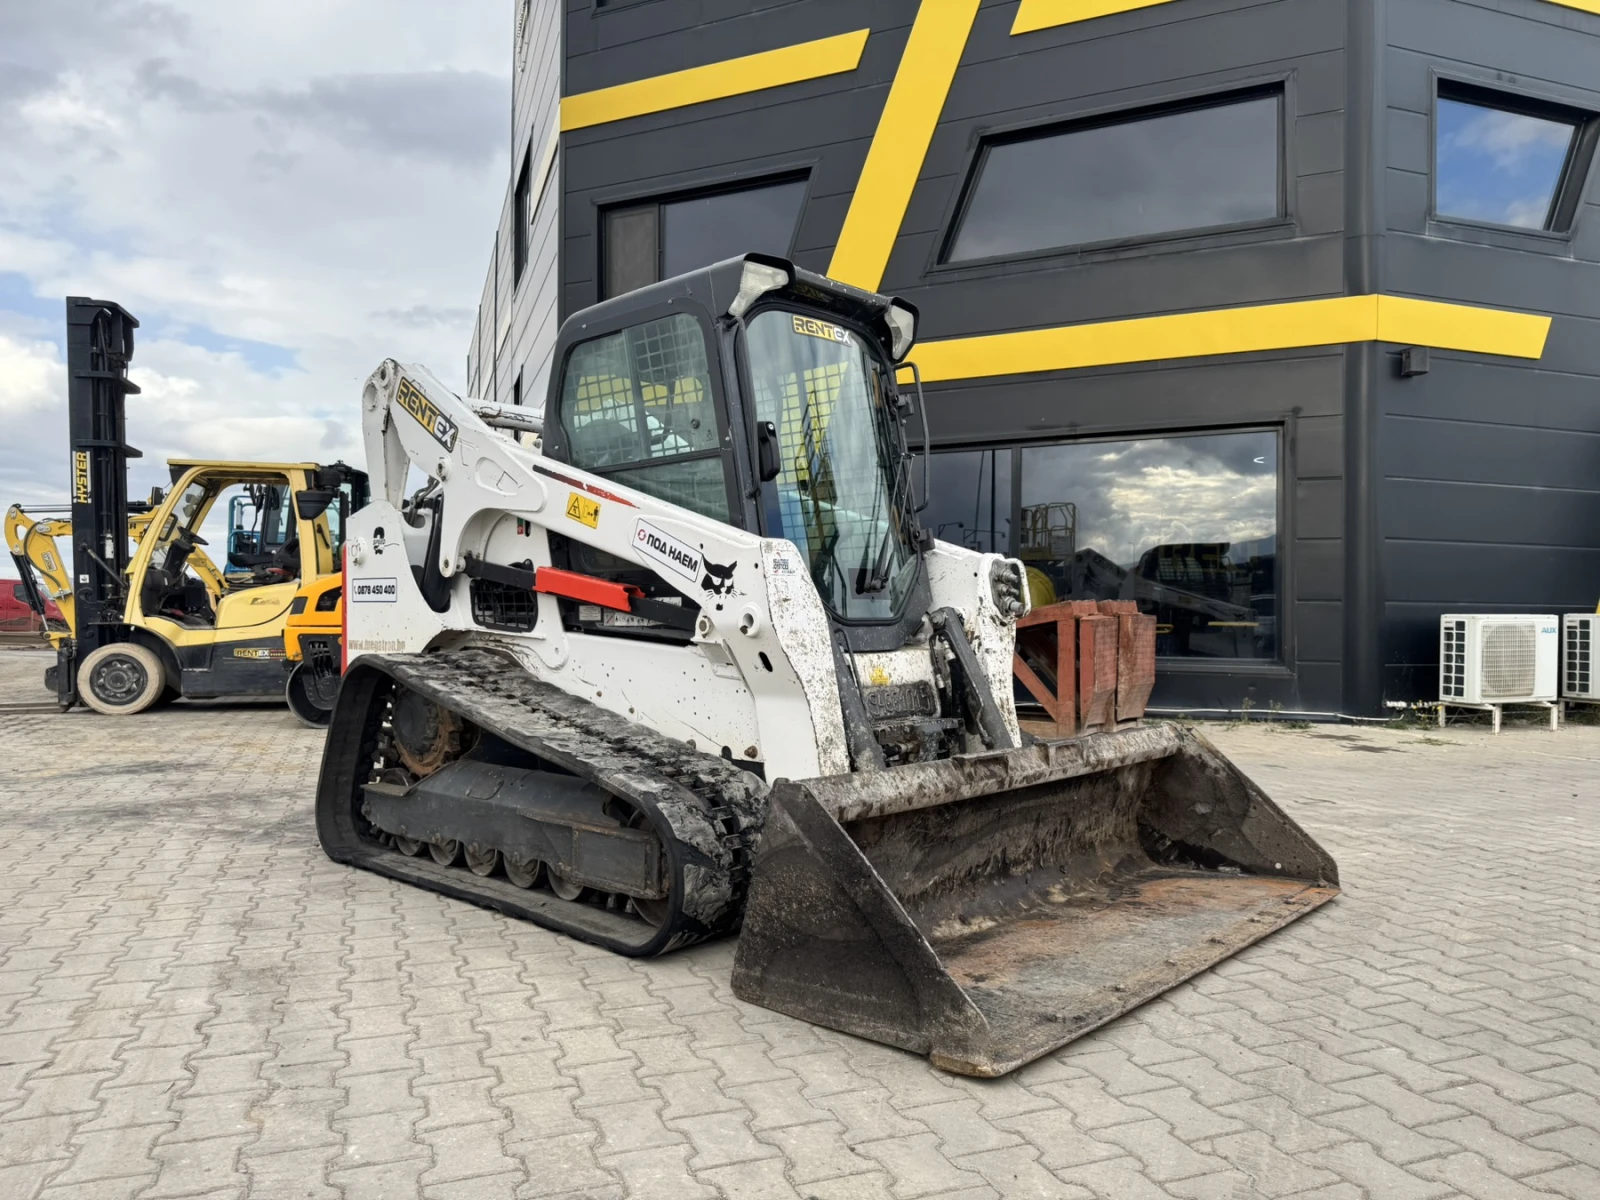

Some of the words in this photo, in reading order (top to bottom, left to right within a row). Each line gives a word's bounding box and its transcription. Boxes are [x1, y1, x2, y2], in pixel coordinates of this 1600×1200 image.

[794, 317, 851, 345] RENTEX
[398, 381, 456, 448] RENTEX
[76, 452, 87, 503] HYSTER
[646, 533, 667, 555] ПОД
[668, 545, 699, 572] НАЕМ
[357, 585, 371, 595] 0878
[371, 585, 383, 595] 450
[383, 585, 396, 595] 400
[1541, 626, 1556, 634] AUX
